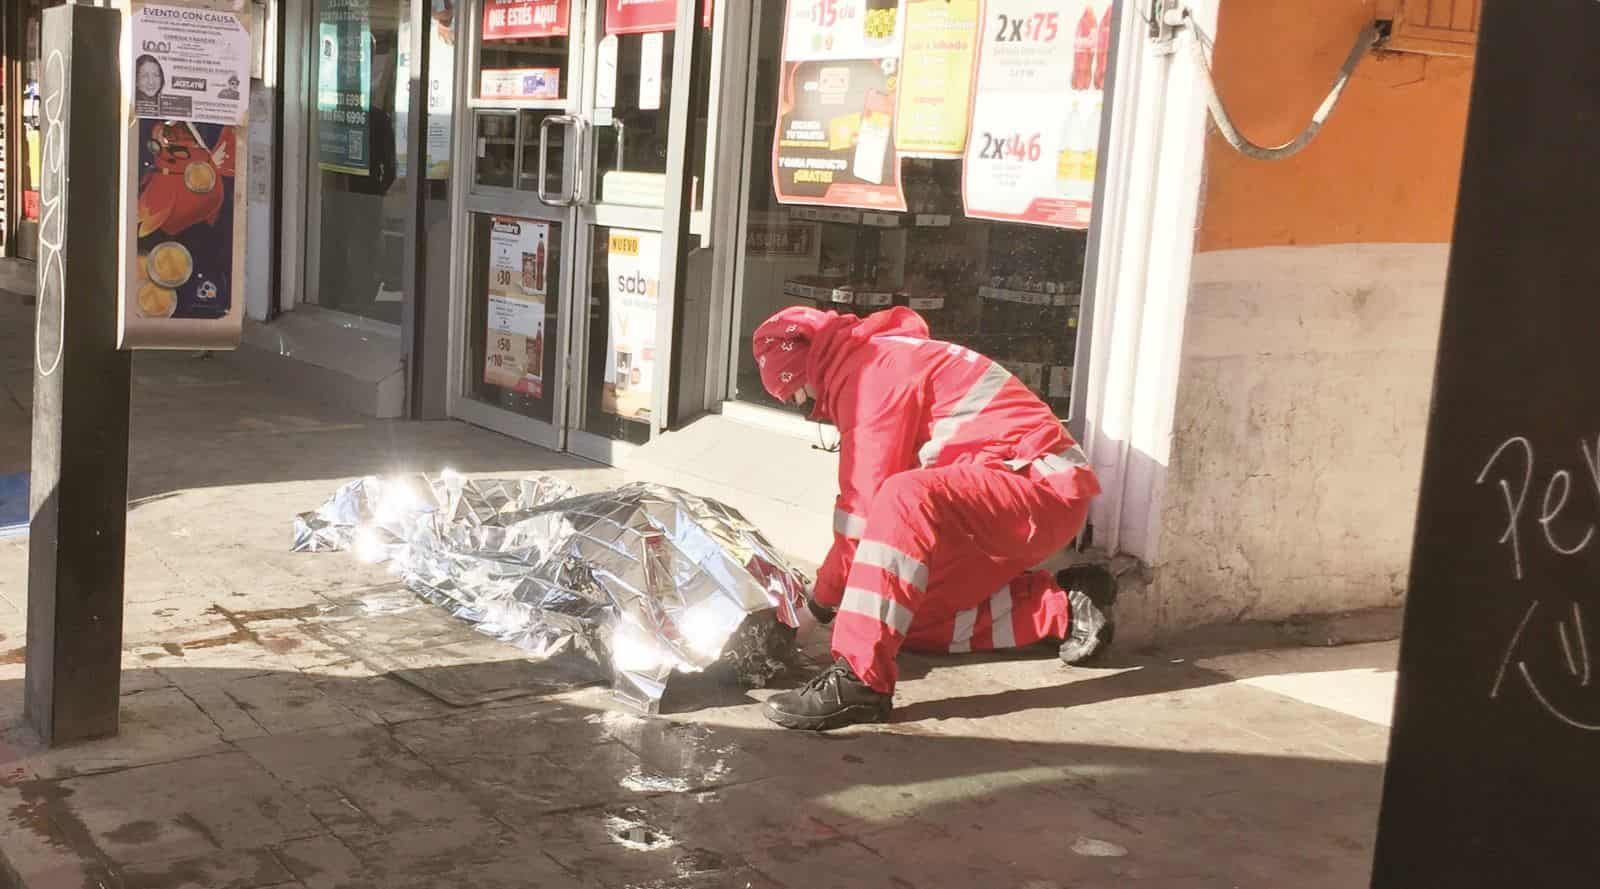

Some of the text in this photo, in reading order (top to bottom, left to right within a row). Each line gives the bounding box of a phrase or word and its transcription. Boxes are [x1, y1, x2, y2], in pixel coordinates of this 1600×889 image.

[143, 7, 236, 24] EVENTO CON CAUSA
[488, 9, 505, 31] QUE
[507, 3, 532, 26] ESTÉS
[812, 0, 837, 27] $15
[611, 238, 638, 253] NUEVO
[497, 270, 511, 285] $30
